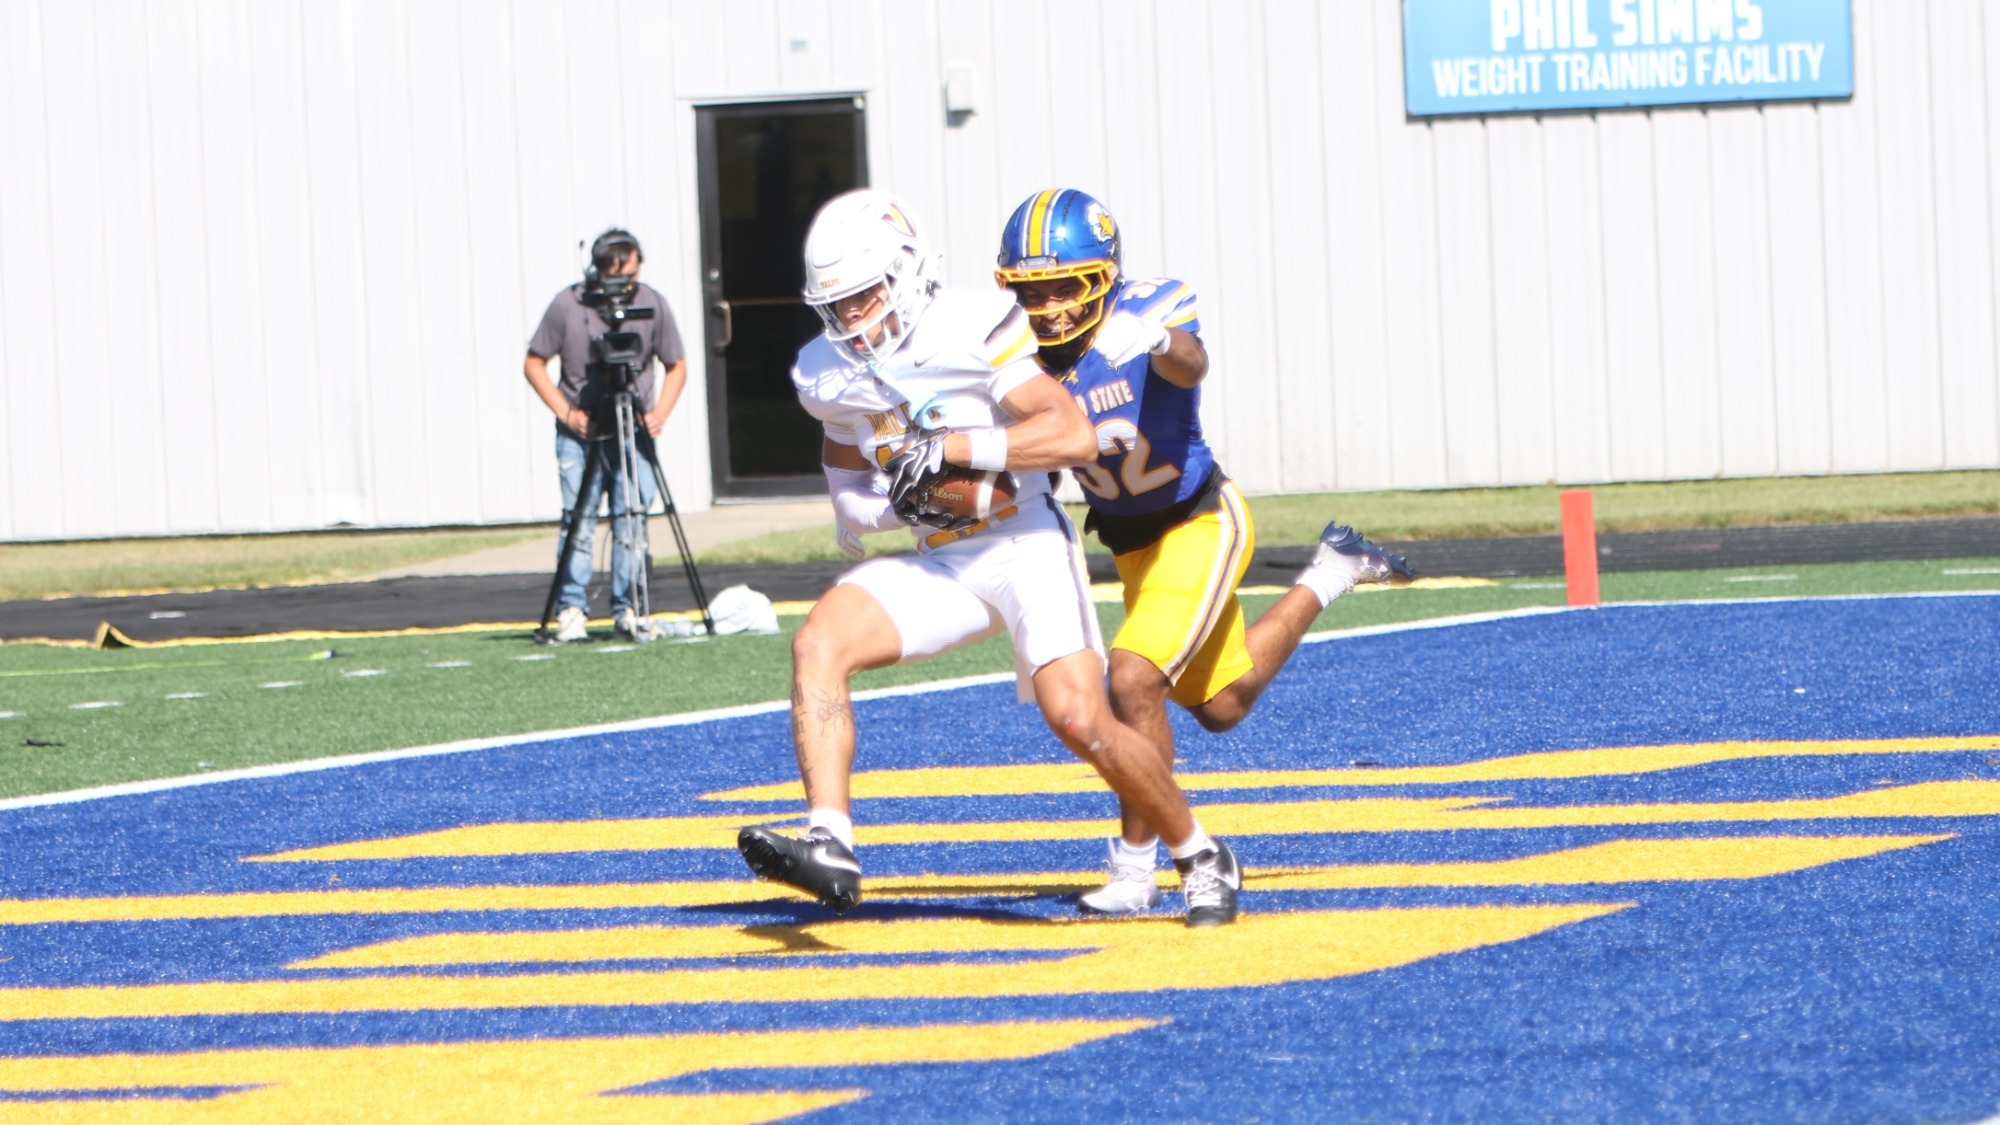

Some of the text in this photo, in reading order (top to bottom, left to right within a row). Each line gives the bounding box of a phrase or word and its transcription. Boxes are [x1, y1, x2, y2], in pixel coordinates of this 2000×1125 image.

[1490, 0, 1763, 51] PHIL SIMMS
[1432, 41, 1826, 98] WEIGHT TRAINING FACILITY
[1089, 379, 1134, 414] STATE
